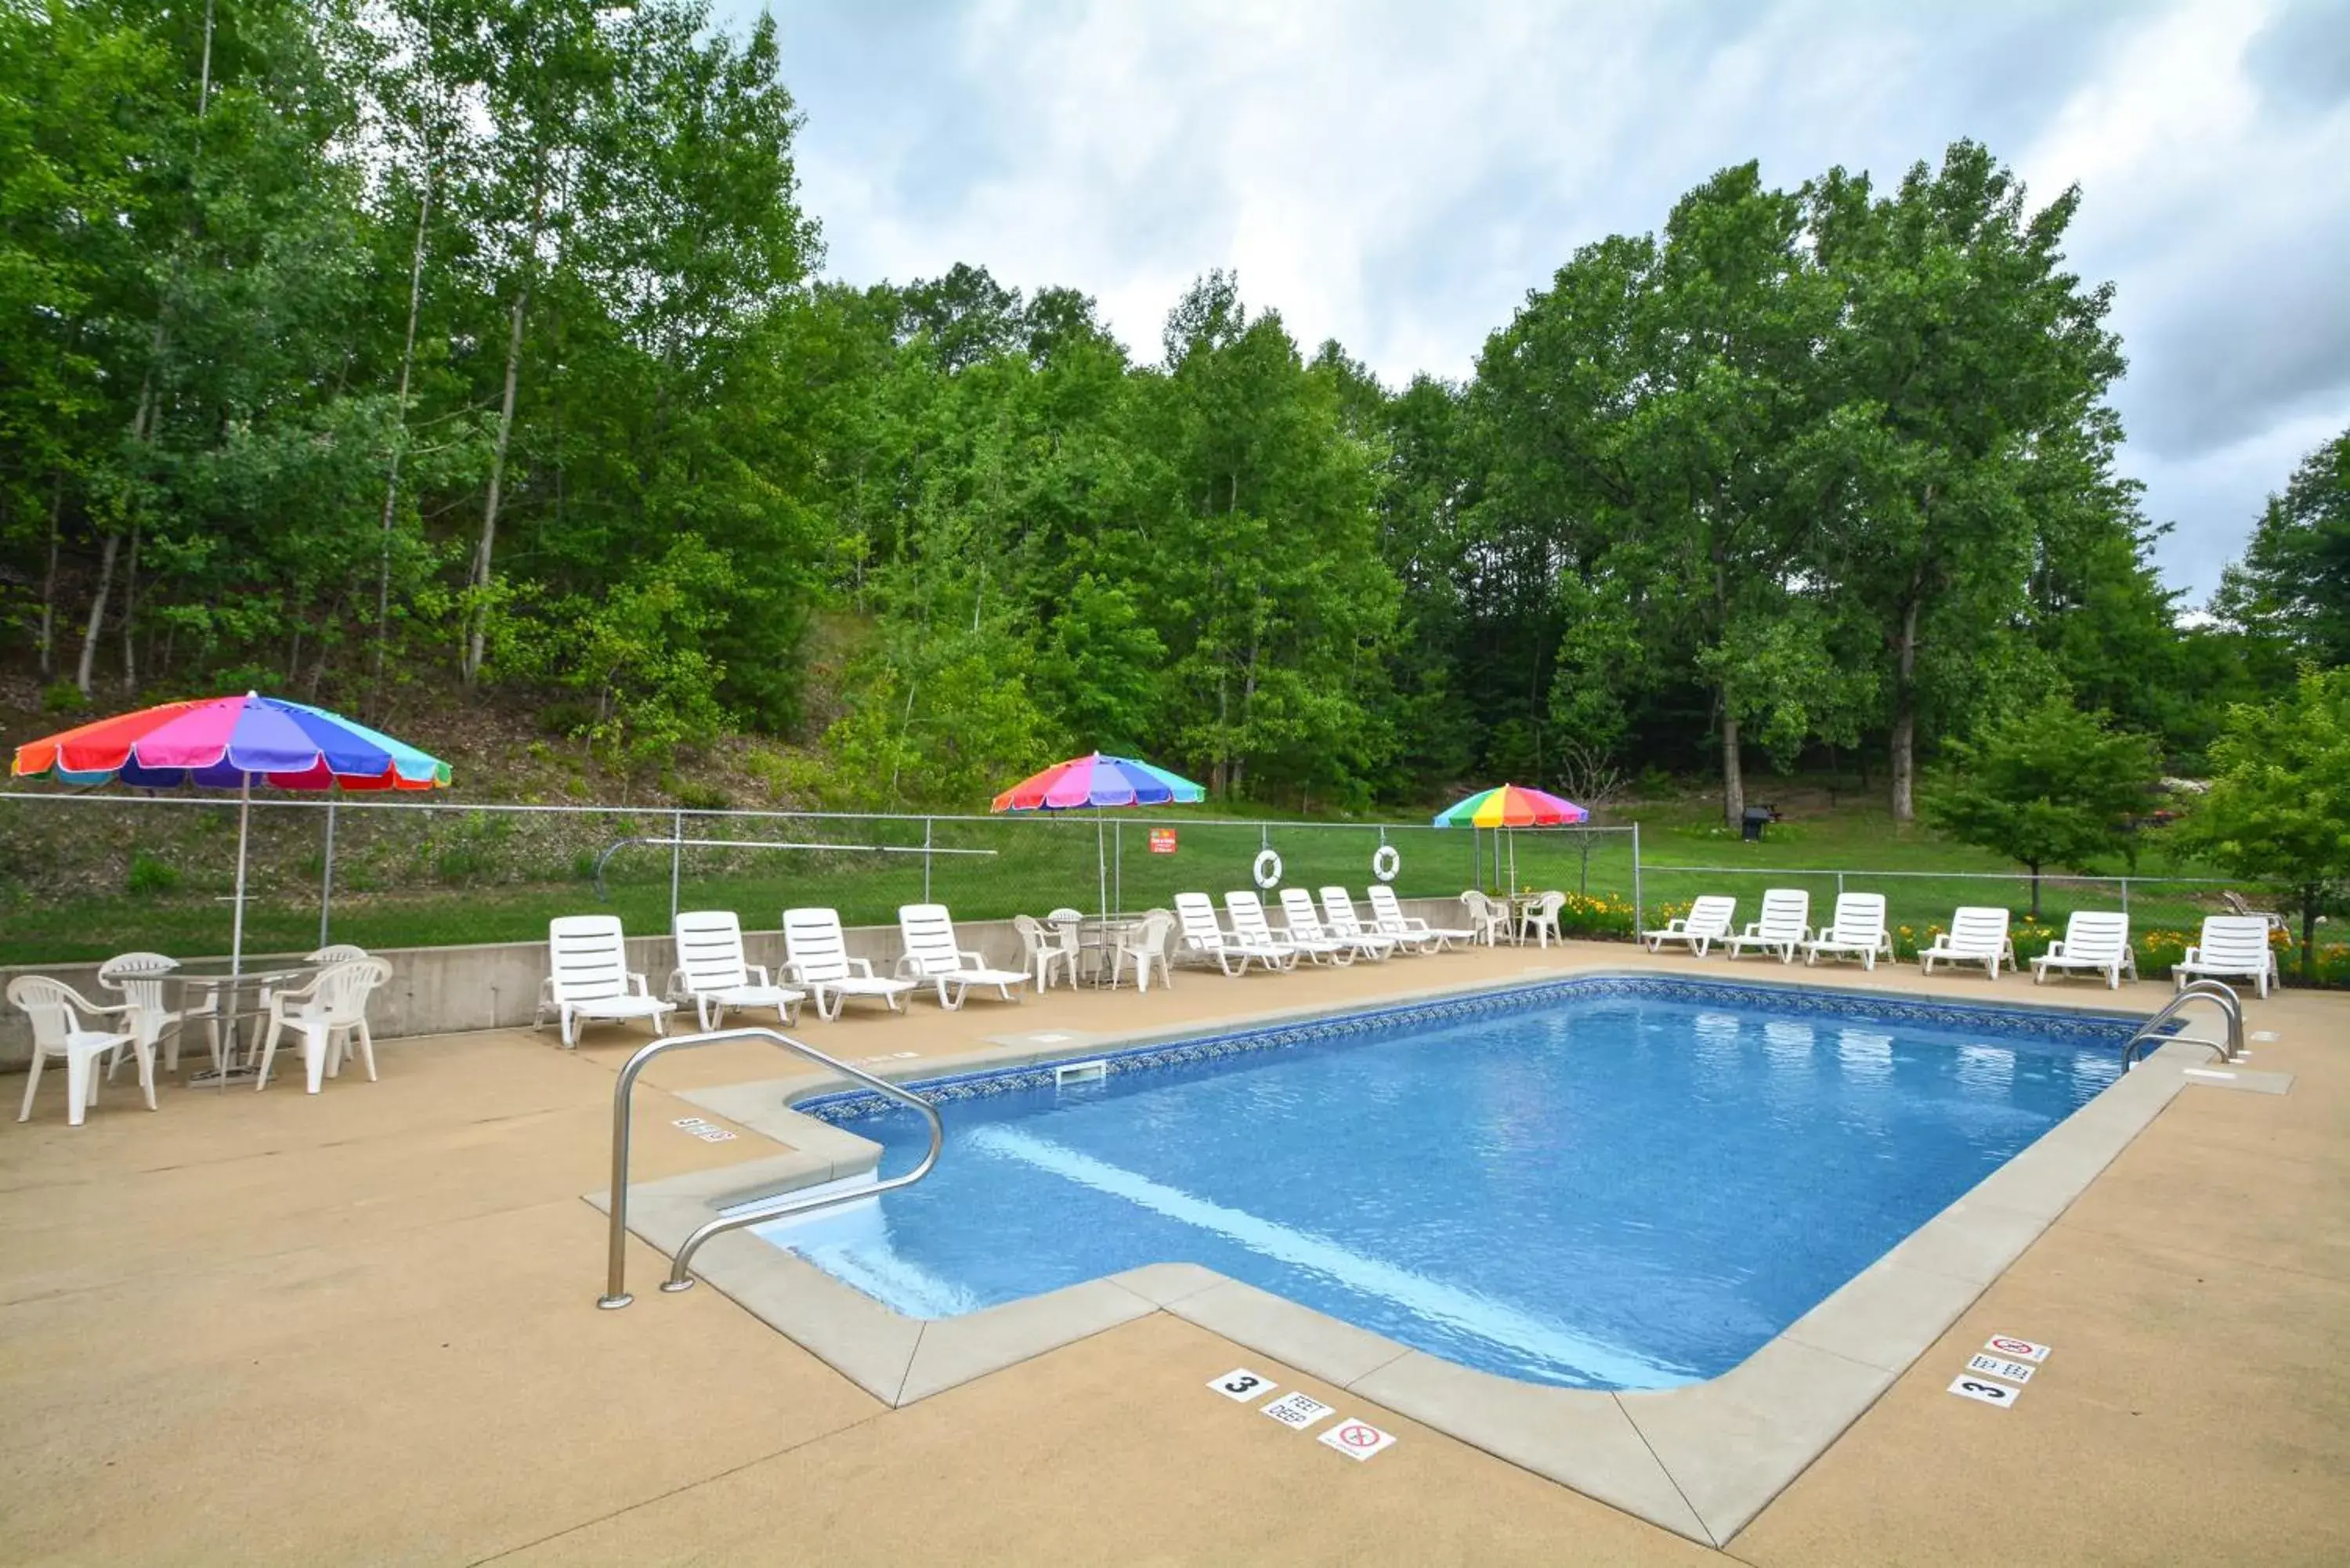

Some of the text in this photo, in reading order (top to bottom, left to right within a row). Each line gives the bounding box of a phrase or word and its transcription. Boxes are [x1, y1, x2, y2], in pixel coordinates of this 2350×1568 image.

[1225, 1376, 1260, 1393] 3
[1962, 1382, 2006, 1398] 3
[1269, 1404, 1307, 1422] DEEP
[1289, 1396, 1325, 1413] FEET
